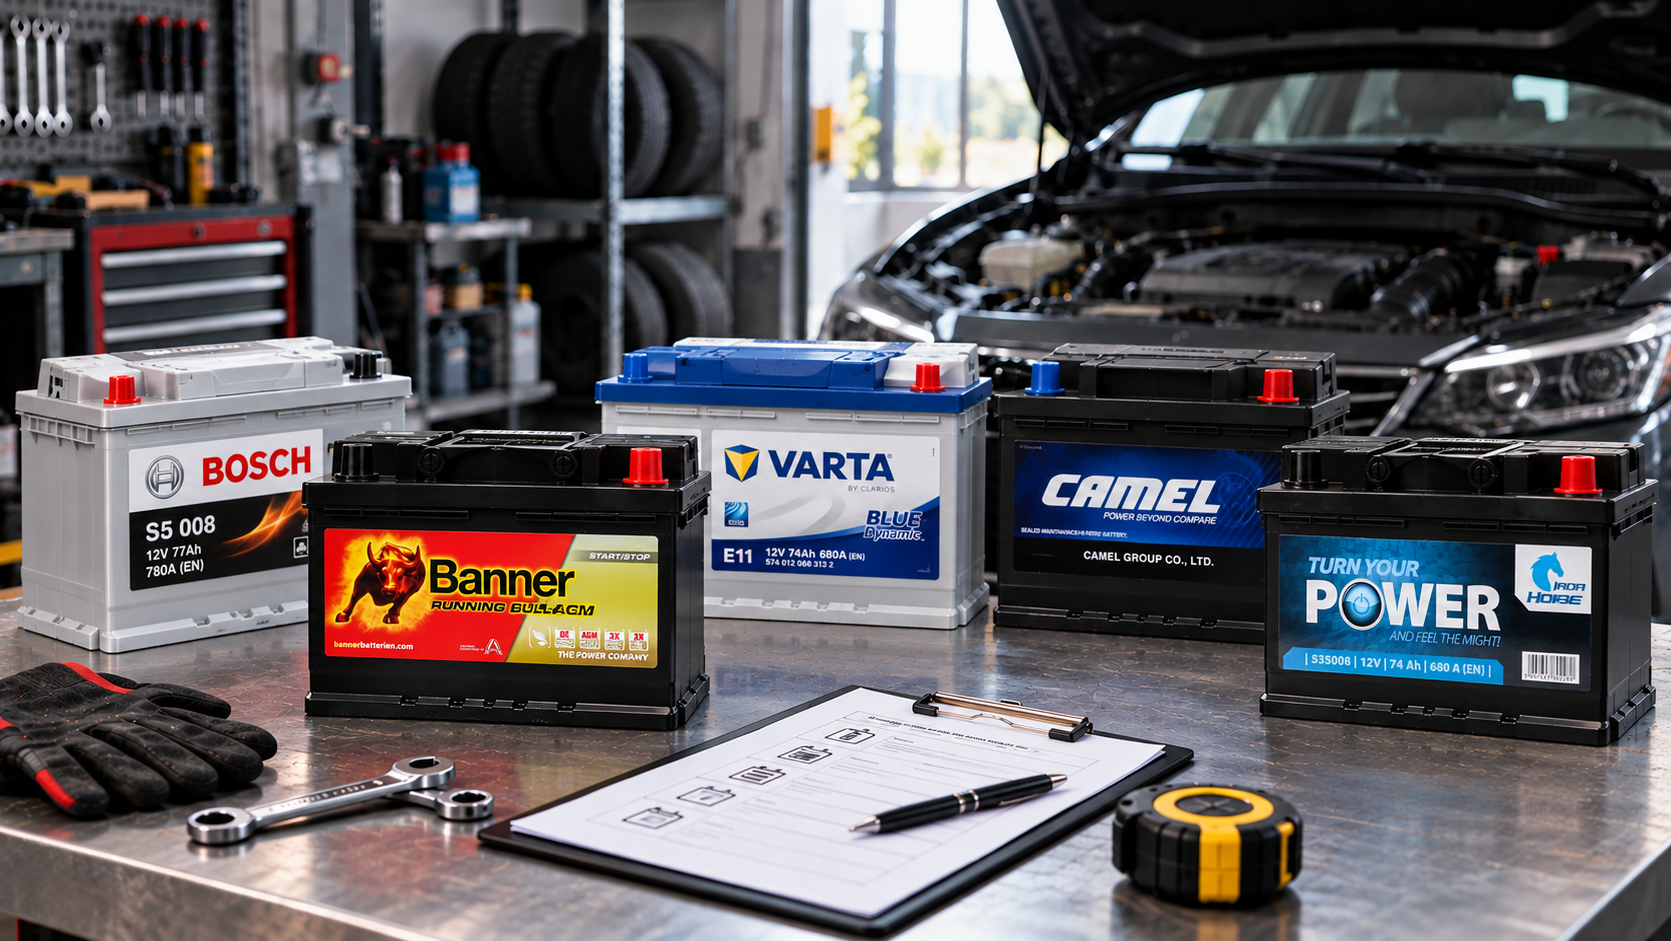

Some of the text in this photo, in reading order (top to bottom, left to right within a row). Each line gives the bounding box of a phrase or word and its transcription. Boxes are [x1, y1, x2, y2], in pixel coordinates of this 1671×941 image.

[202, 446, 311, 486] BOSCH
[1041, 474, 1221, 514] CAMEL
[866, 509, 923, 527] BLUE
[1103, 511, 1217, 525] POWER BEYOND COMPARE
[146, 515, 216, 542] S5 008
[863, 526, 923, 542] Dynamic
[146, 544, 202, 562] 12V 77Ah
[589, 552, 651, 561] START/STOP
[723, 547, 752, 564] E11
[765, 547, 866, 561] 12V 74Ah 680A (EN)
[1083, 550, 1214, 567] CAMEL GROUP CO., LTD.
[146, 559, 205, 578] 780A (EN)
[781, 559, 795, 567] 012
[1308, 556, 1420, 577] TURN YOUR
[430, 559, 575, 597] Banner
[431, 601, 506, 612] RUNNING
[1306, 578, 1501, 631] POWER
[1388, 630, 1501, 648] AND FEEL THE MIGHT!
[557, 651, 575, 659] THE
[576, 651, 606, 660] POWER
[1360, 657, 1381, 668] 12V
[1389, 658, 1403, 670] 74
[1406, 659, 1421, 671] Ah
[1429, 661, 1450, 672] 680
[1452, 663, 1460, 673] A
[1462, 663, 1485, 677] (EN)
